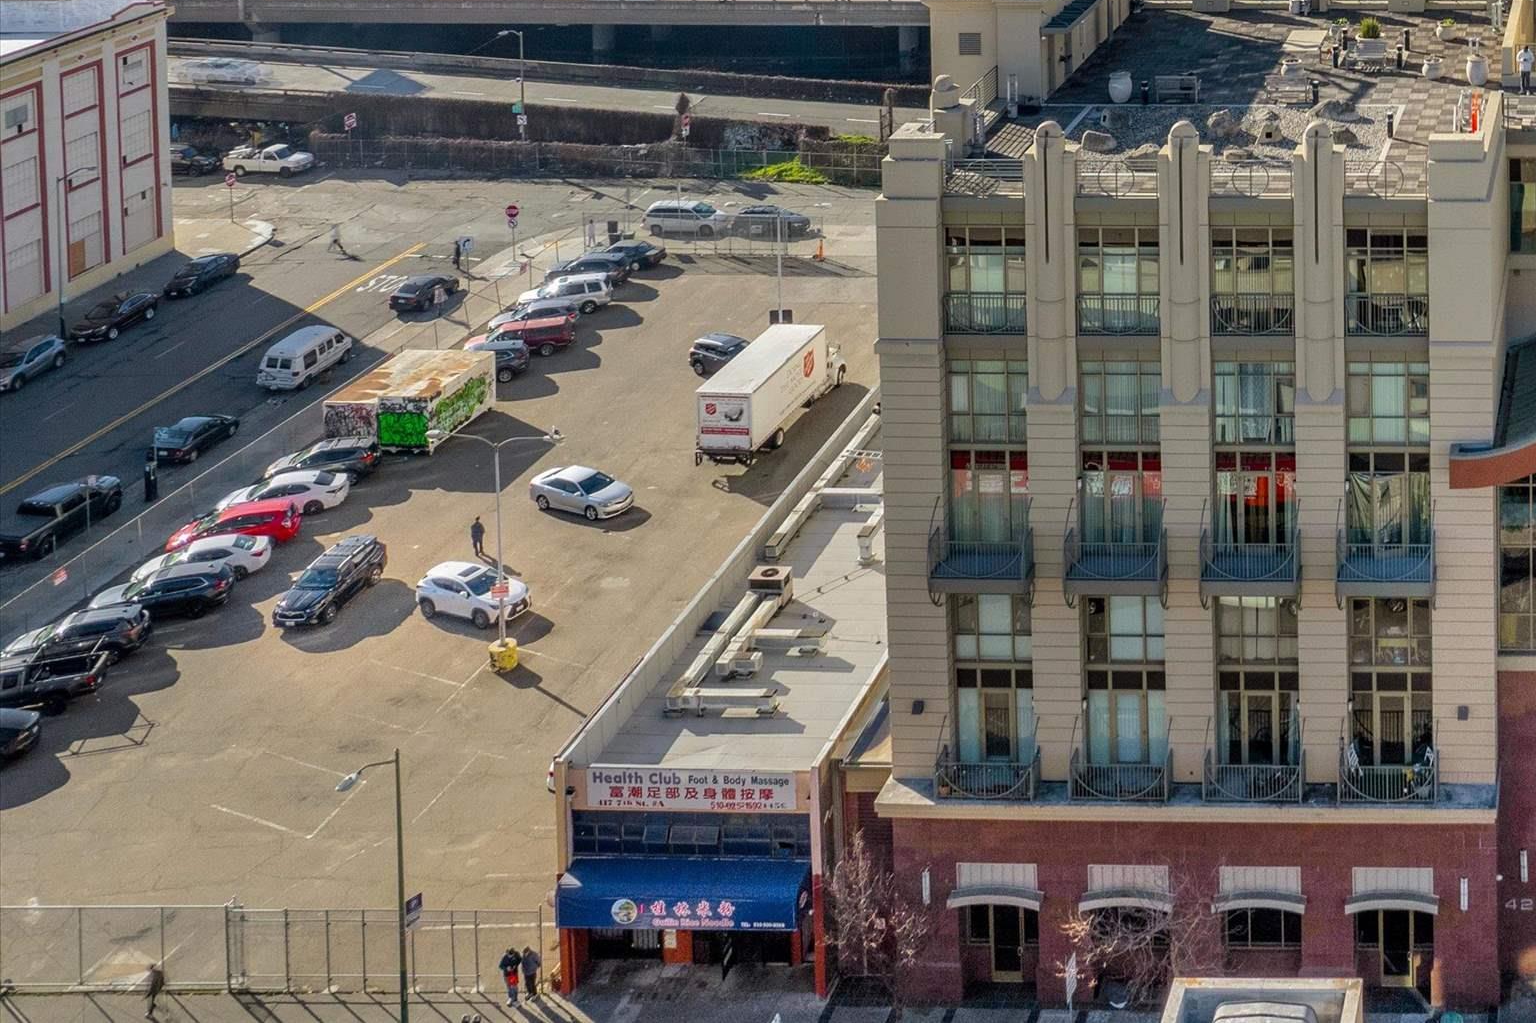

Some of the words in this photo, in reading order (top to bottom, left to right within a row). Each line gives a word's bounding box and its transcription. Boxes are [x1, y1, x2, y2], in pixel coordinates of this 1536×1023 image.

[592, 772, 643, 784] Health
[649, 773, 681, 785] Club
[688, 775, 708, 785] Foot
[712, 775, 719, 785] &
[723, 775, 746, 787] Body
[750, 776, 790, 787] Massage
